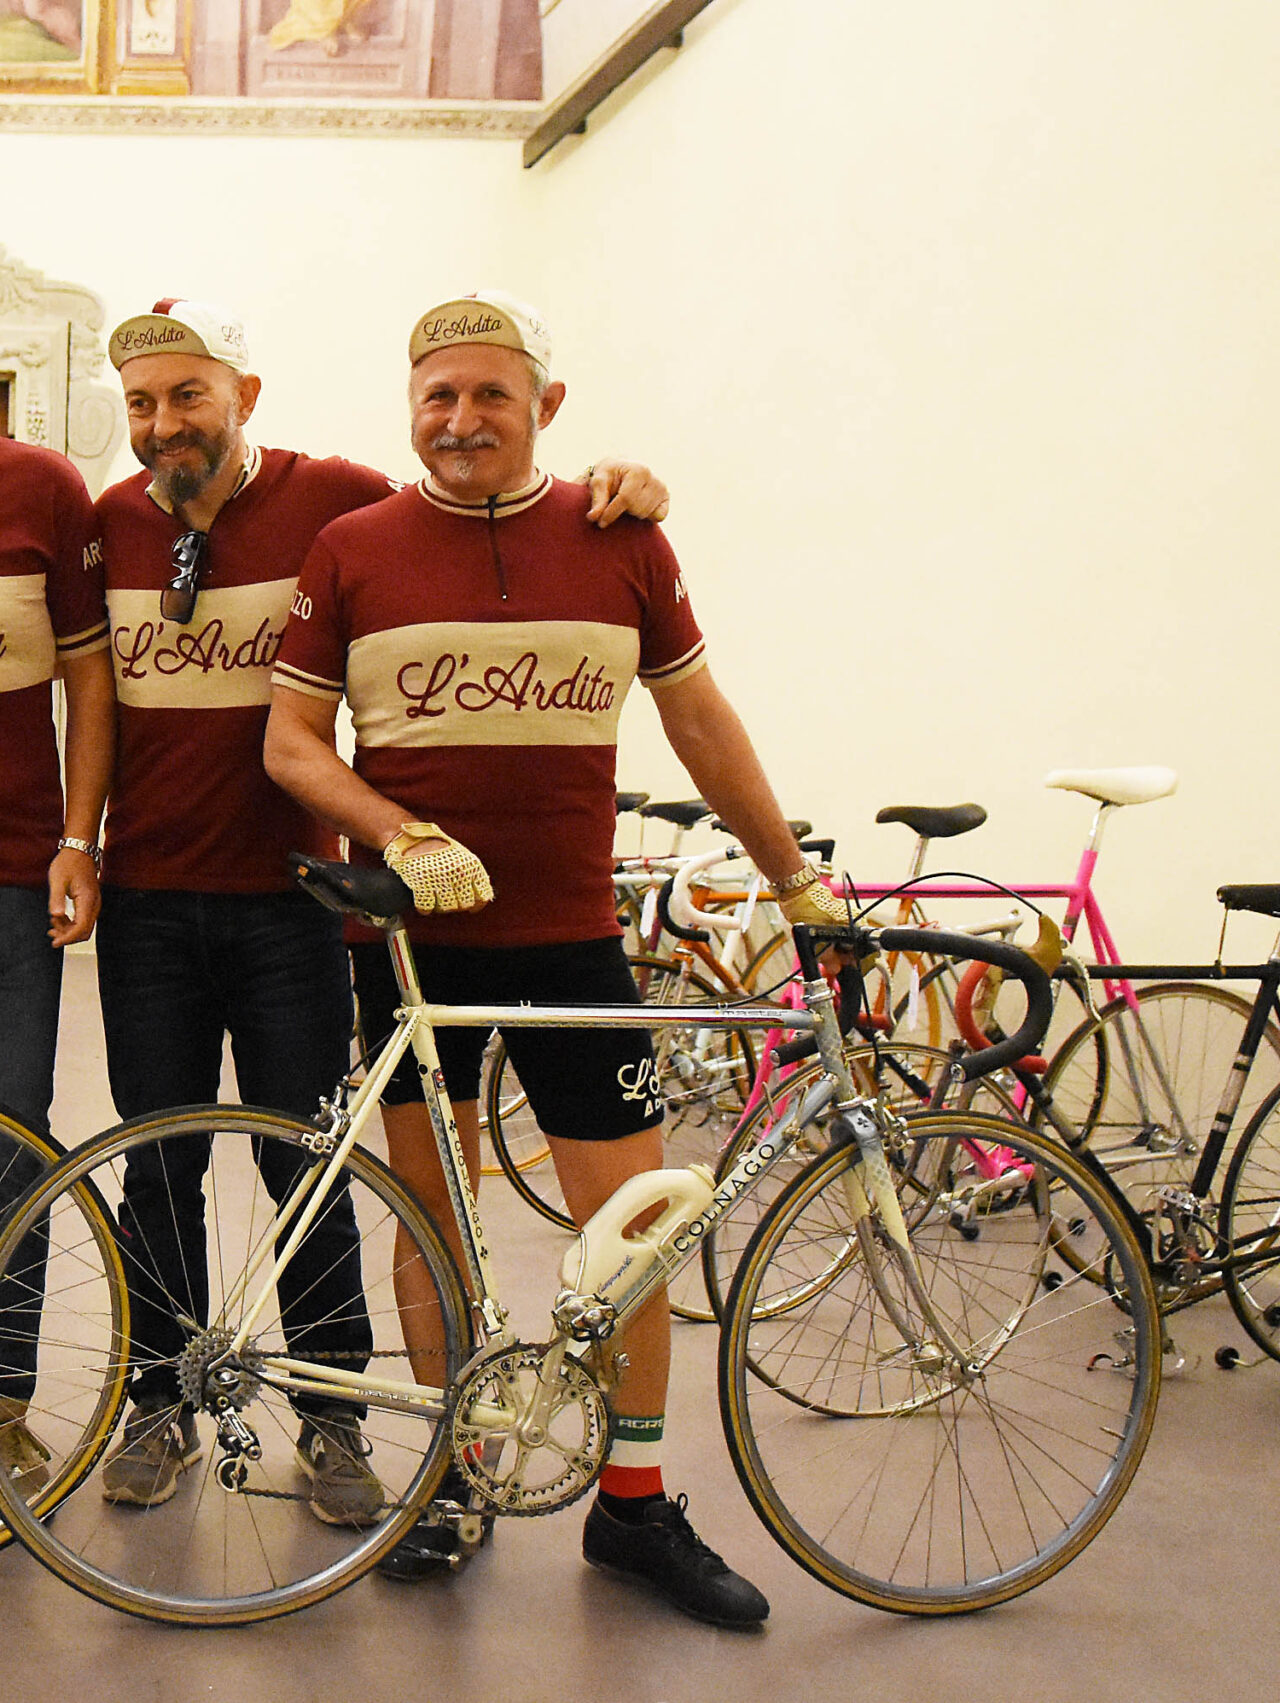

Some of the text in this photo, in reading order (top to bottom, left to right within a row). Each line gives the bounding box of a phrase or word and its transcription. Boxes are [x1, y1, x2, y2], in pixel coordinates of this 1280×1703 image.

[117, 325, 186, 351] L'Ardita
[423, 313, 503, 343] L'Ardita
[114, 616, 286, 680] L'Ardit
[396, 651, 615, 719] L'Ardita
[454, 1140, 483, 1239] COLNAGO
[673, 1143, 775, 1253] COLNAGO
